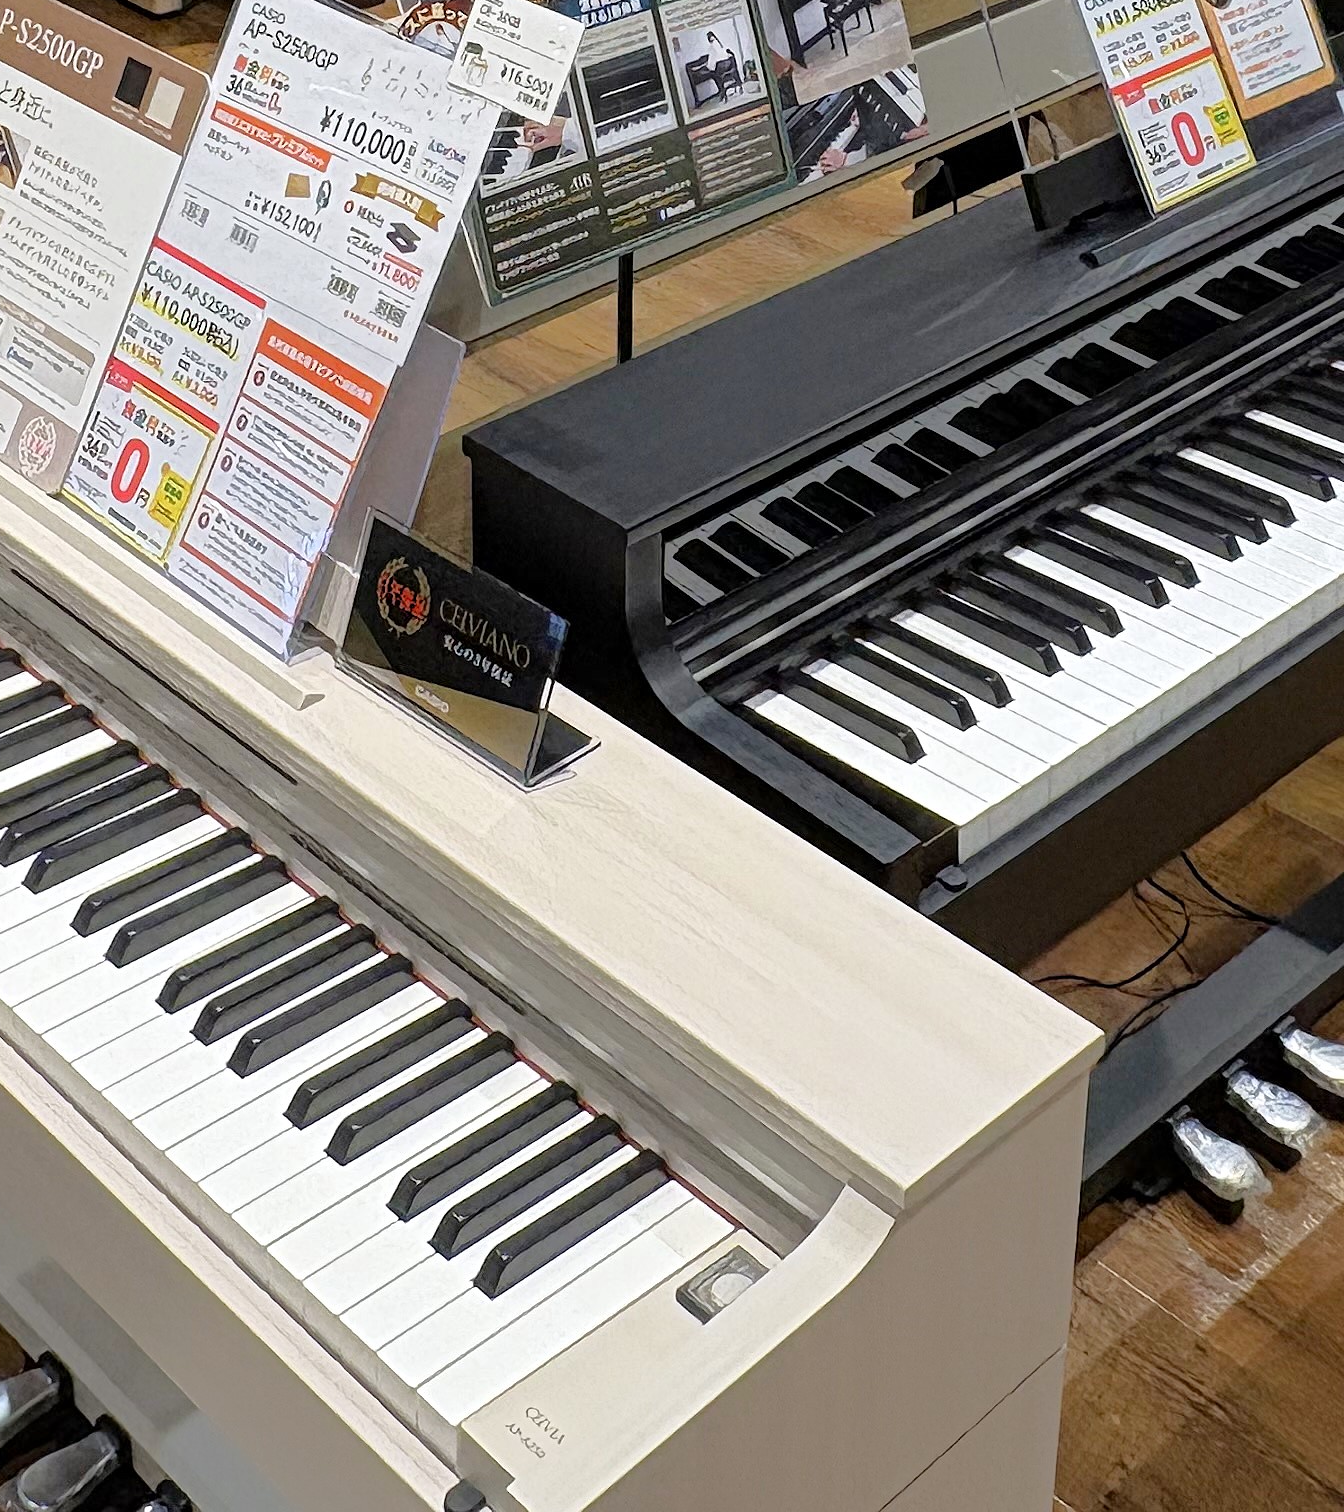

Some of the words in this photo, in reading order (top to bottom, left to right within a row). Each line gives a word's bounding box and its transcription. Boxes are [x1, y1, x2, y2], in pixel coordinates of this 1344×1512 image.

[243, 18, 339, 71] AP-S2500GP
[319, 105, 406, 166] ¥110,000
[439, 598, 531, 669] CELVIANO
